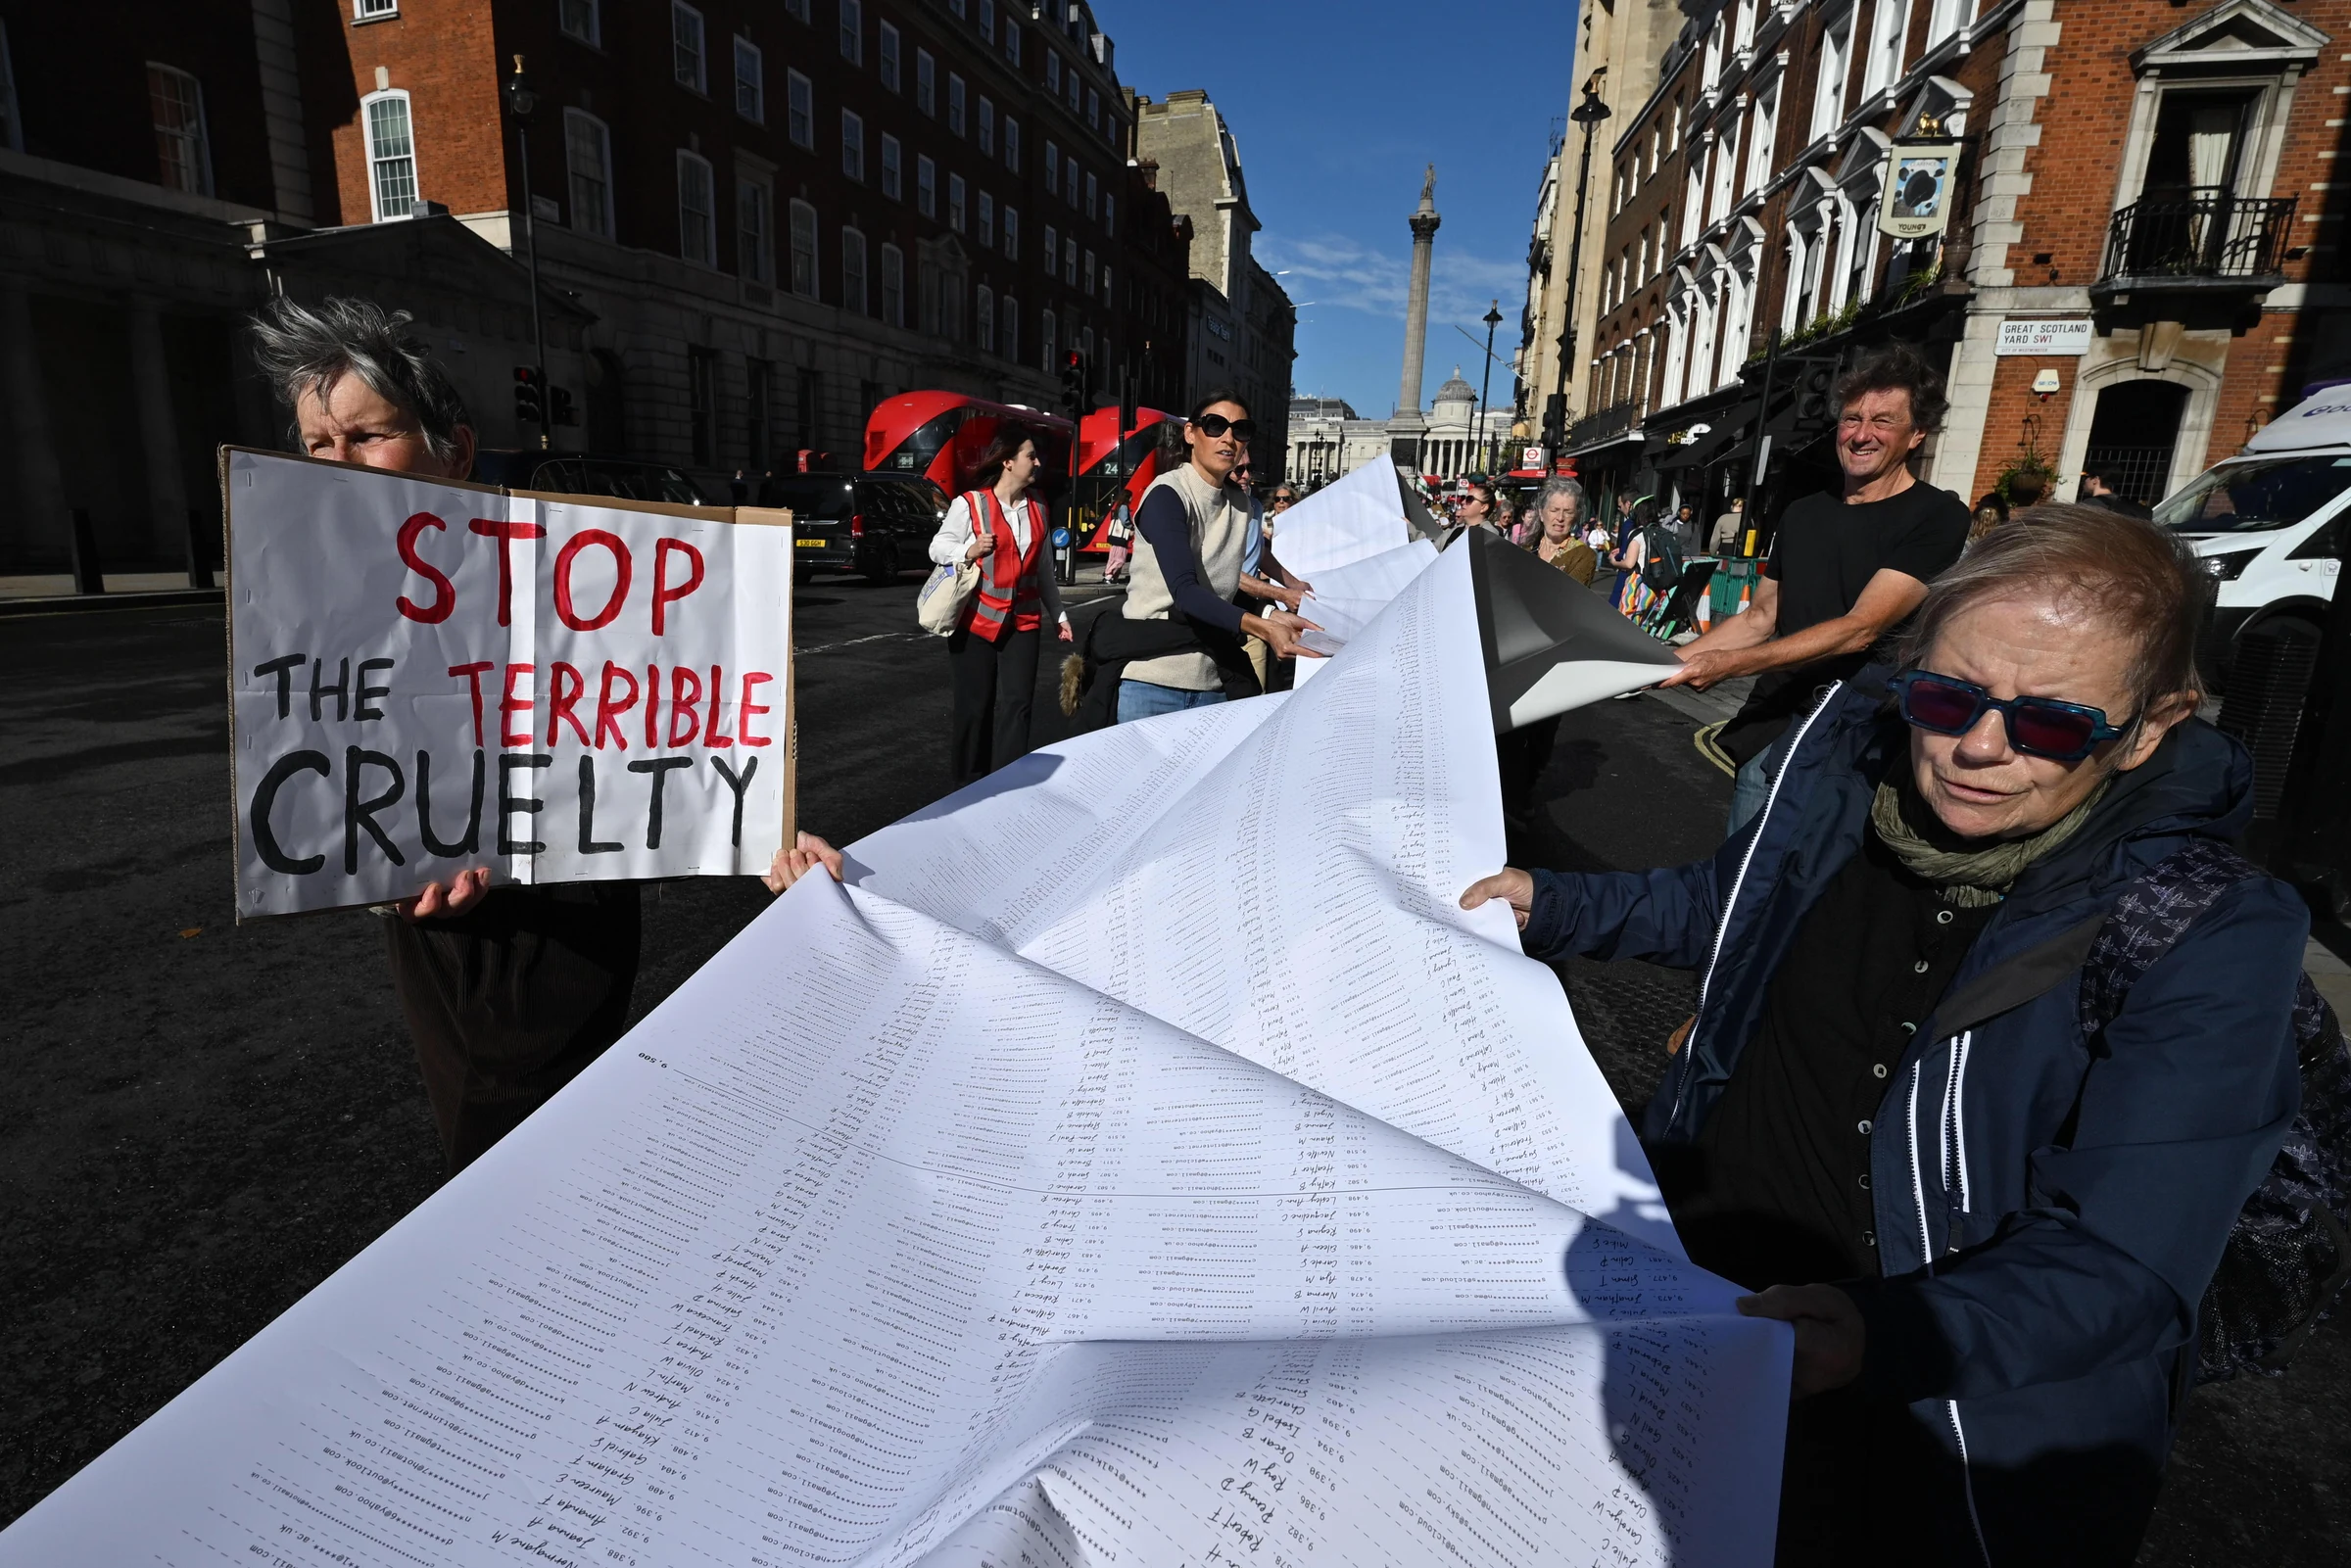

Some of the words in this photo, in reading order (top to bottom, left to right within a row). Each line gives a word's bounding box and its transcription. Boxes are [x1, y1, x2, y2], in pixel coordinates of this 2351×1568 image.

[2005, 325, 2034, 333] GREAT
[2040, 324, 2087, 333] SCOTLAND
[2004, 336, 2028, 344] YARD
[2033, 335, 2052, 343] SW1
[1105, 463, 1118, 474] 24
[396, 512, 705, 636] STOP
[254, 653, 395, 721] THE
[448, 660, 773, 751] TERRIBLE
[250, 745, 758, 875] CRUELTY
[638, 1052, 667, 1068] 9,500
[1496, 1104, 1521, 1117] Warren
[1488, 1113, 1494, 1124] R
[1307, 1224, 1337, 1237] Regina
[1034, 1249, 1070, 1260] Charlotte
[1300, 1244, 1309, 1253] A
[1312, 1244, 1337, 1253] Eileen
[1026, 1261, 1035, 1270] P
[1038, 1262, 1066, 1274] Dorota
[1038, 1274, 1063, 1289] Lucy
[1306, 1275, 1317, 1283] M
[1024, 1292, 1059, 1304] Rebecca
[1294, 1290, 1302, 1299] B
[1307, 1291, 1338, 1300] Norma
[1011, 1306, 1022, 1314] M
[1024, 1308, 1055, 1320] Gillian
[1312, 1306, 1337, 1314] Avril
[987, 1314, 996, 1322] P
[1000, 1317, 1050, 1336] Aleksandra
[676, 1341, 713, 1360] Andrea
[660, 1356, 674, 1365] W
[646, 1368, 656, 1378] L
[676, 1360, 704, 1377] Olivia
[1628, 1363, 1635, 1374] L
[623, 1382, 638, 1391] N
[657, 1373, 694, 1393] Martin
[1641, 1371, 1669, 1397] Maria
[1275, 1386, 1308, 1398] Simon
[1628, 1384, 1635, 1397] L
[640, 1388, 682, 1409] Andrew
[1251, 1394, 1305, 1415] Charlotte
[629, 1406, 640, 1416] C
[1247, 1406, 1259, 1417] G
[1639, 1391, 1665, 1420] David
[595, 1415, 610, 1425] A
[642, 1410, 673, 1427] Julia
[1630, 1412, 1640, 1425] N
[1262, 1413, 1301, 1439] Isobel
[1641, 1421, 1661, 1443] Gail
[612, 1423, 661, 1447] Khayam
[1242, 1428, 1254, 1439] B
[1621, 1430, 1630, 1444] G
[604, 1441, 647, 1465] Gabriel
[1260, 1437, 1294, 1464] Oscar
[1609, 1451, 1618, 1463] A
[1634, 1442, 1656, 1468] Olivia
[586, 1460, 634, 1485] Graham
[1243, 1458, 1258, 1474] W
[555, 1473, 569, 1483] E
[1221, 1477, 1235, 1491] D
[1260, 1462, 1287, 1493] Roy
[570, 1479, 622, 1506] Maureen
[1612, 1485, 1621, 1498] P
[1236, 1481, 1275, 1524] Penny
[1593, 1501, 1604, 1516] W
[1623, 1493, 1647, 1518] Clare
[557, 1499, 607, 1526] Amanda
[1207, 1506, 1222, 1523] F
[527, 1516, 544, 1528] A
[1607, 1510, 1642, 1545] Carolyn
[491, 1530, 510, 1543] M
[547, 1523, 595, 1549] Joanna
[1221, 1512, 1264, 1553] Robert
[1602, 1538, 1610, 1550] C
[1205, 1543, 1222, 1563] H
